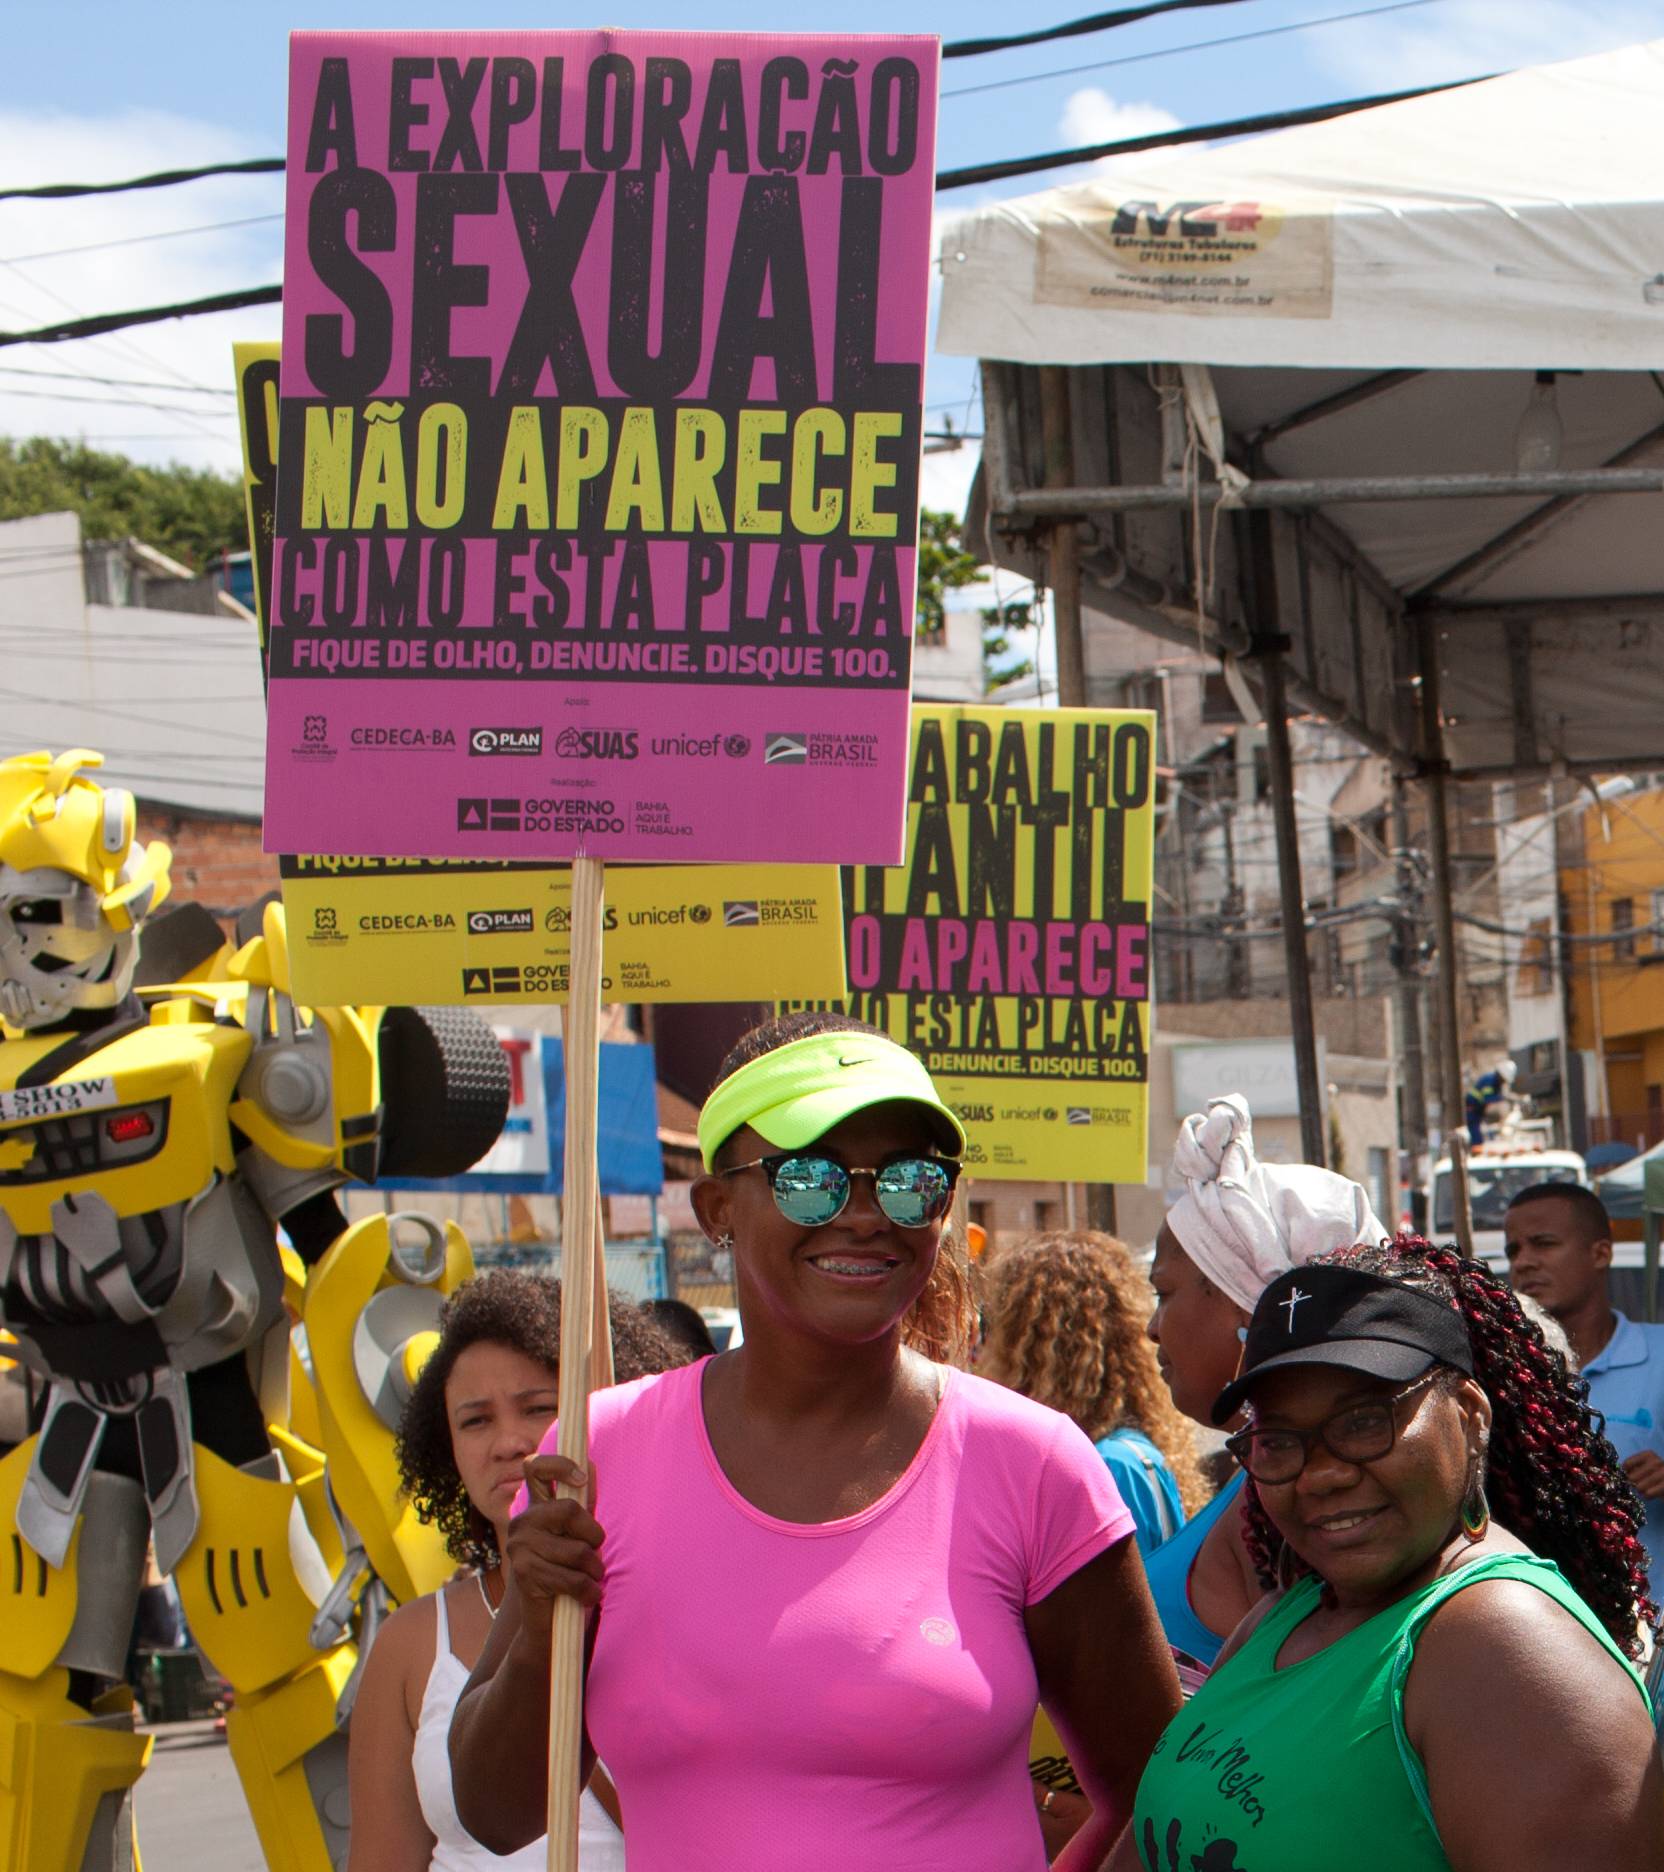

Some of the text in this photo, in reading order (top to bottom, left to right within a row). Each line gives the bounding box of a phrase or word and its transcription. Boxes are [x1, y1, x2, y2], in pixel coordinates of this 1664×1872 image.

[305, 56, 919, 178] A EXPLORAÇÃO
[304, 165, 921, 403] SEXUAL
[301, 400, 904, 538] NÃO APARECE
[280, 538, 912, 638] COMO ESTA PLACA
[293, 638, 897, 680] FIQUE DE OLHO, DENUNCIE. DISQUE 100.
[351, 728, 456, 746] CEDECA-BA
[500, 733, 540, 746] PLAN
[580, 731, 639, 759] SUAS
[652, 734, 721, 756] unicef
[809, 744, 878, 761] BRASIL
[525, 800, 614, 815] GOVERNO
[525, 817, 624, 833] DO ESTADO
[360, 914, 456, 929] CEDECA-BA
[495, 912, 531, 928] PLAN
[629, 905, 687, 925] unicef
[761, 906, 818, 921] BRASIL
[898, 917, 1147, 999] APARECE
[908, 995, 998, 1049] ESTA
[1018, 997, 1149, 1055] PLACA
[929, 1052, 1141, 1078] DENUNCIE. DISQUE 100.
[14, 1078, 105, 1106] SHOW
[1000, 1106, 1042, 1121] unicef
[1211, 1737, 1265, 1828] Melhor
